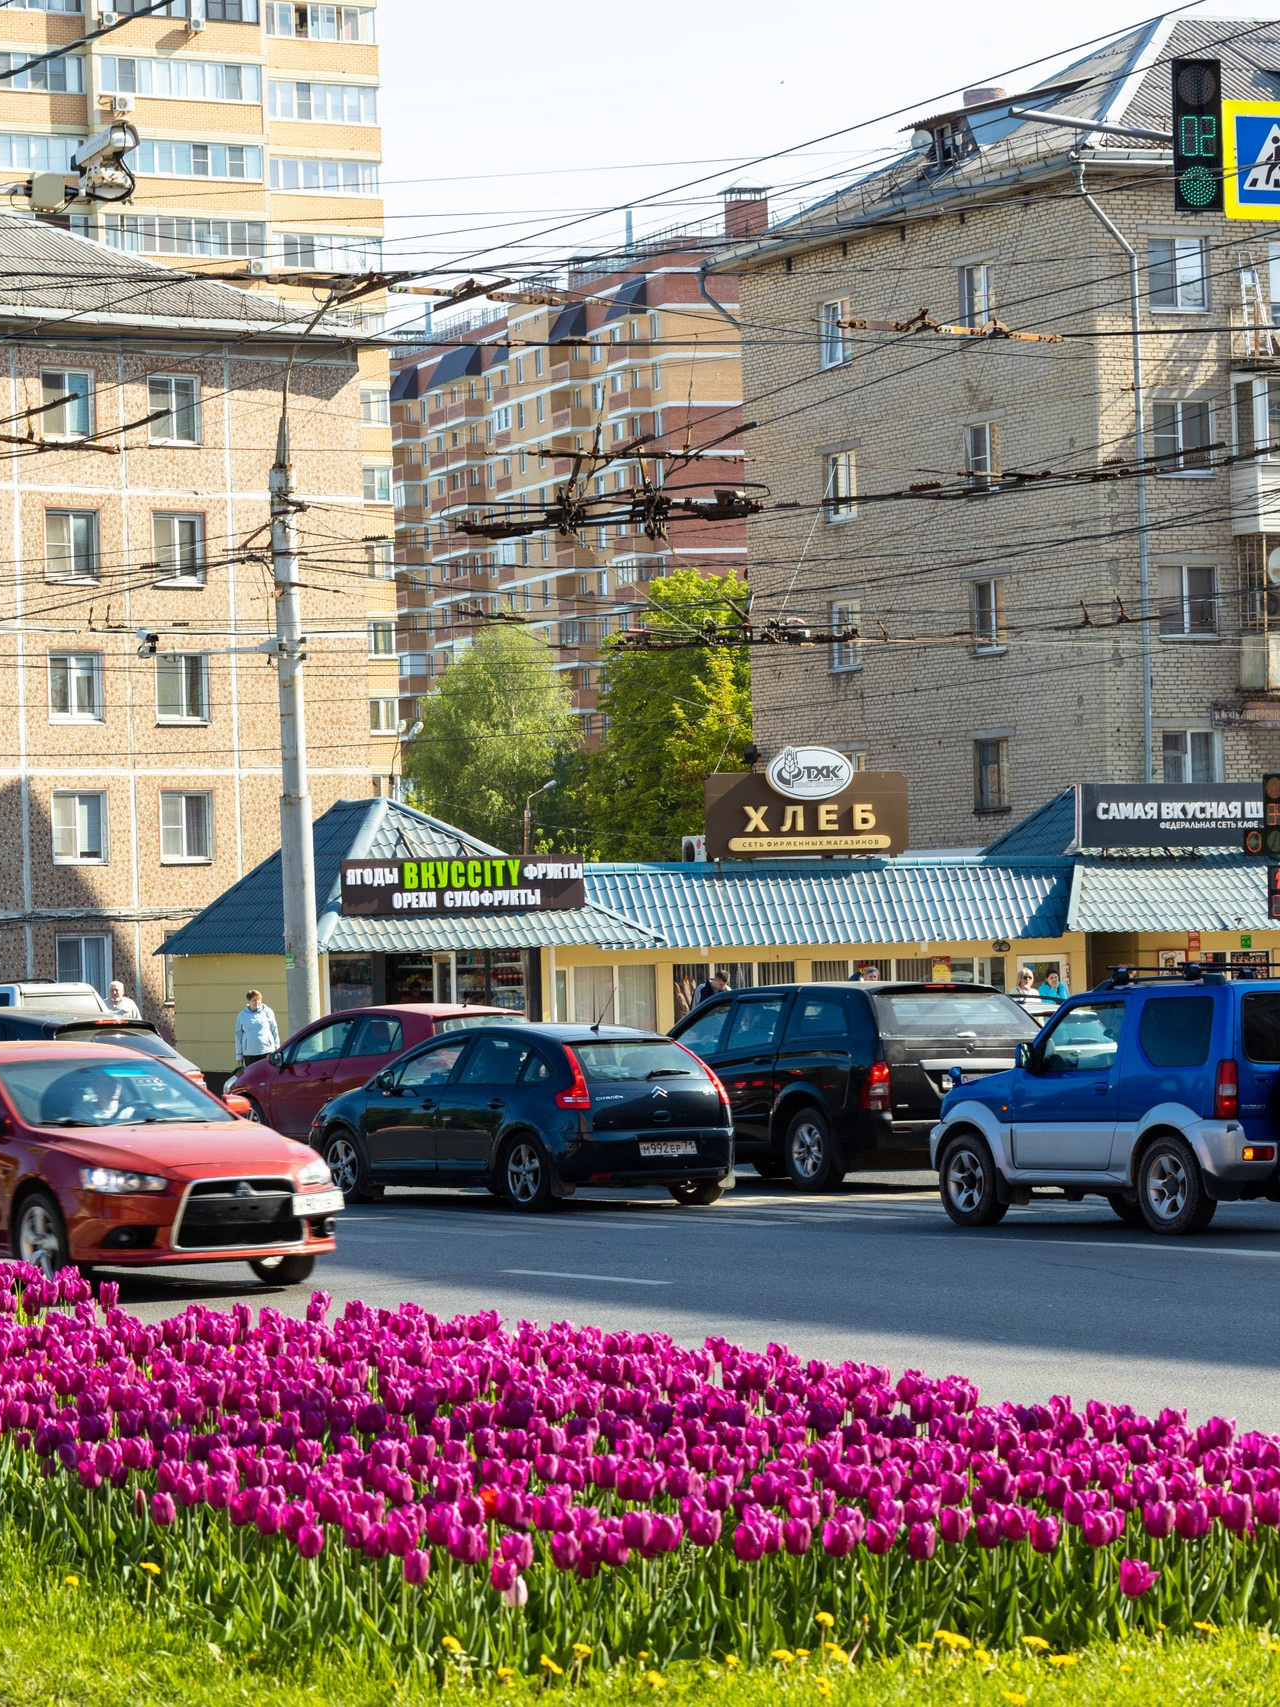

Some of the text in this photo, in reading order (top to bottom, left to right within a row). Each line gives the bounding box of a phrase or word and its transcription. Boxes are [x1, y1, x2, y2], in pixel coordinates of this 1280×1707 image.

[1182, 116, 1216, 156] 02
[742, 803, 877, 832] ХЛЕБ
[1096, 802, 1158, 820] САМАЯ
[1161, 801, 1242, 819] ВКУСНАЯ
[1159, 821, 1216, 829] ФЕДЕРАЛЬНАЯ
[1237, 820, 1258, 828] КАФЕ
[345, 867, 398, 887] ЯГОДЫ
[523, 864, 583, 880] ФРУКТЫ
[392, 889, 541, 909] ОРЕХИ СУХОФРУКТЫ
[683, 1141, 693, 1150] 71
